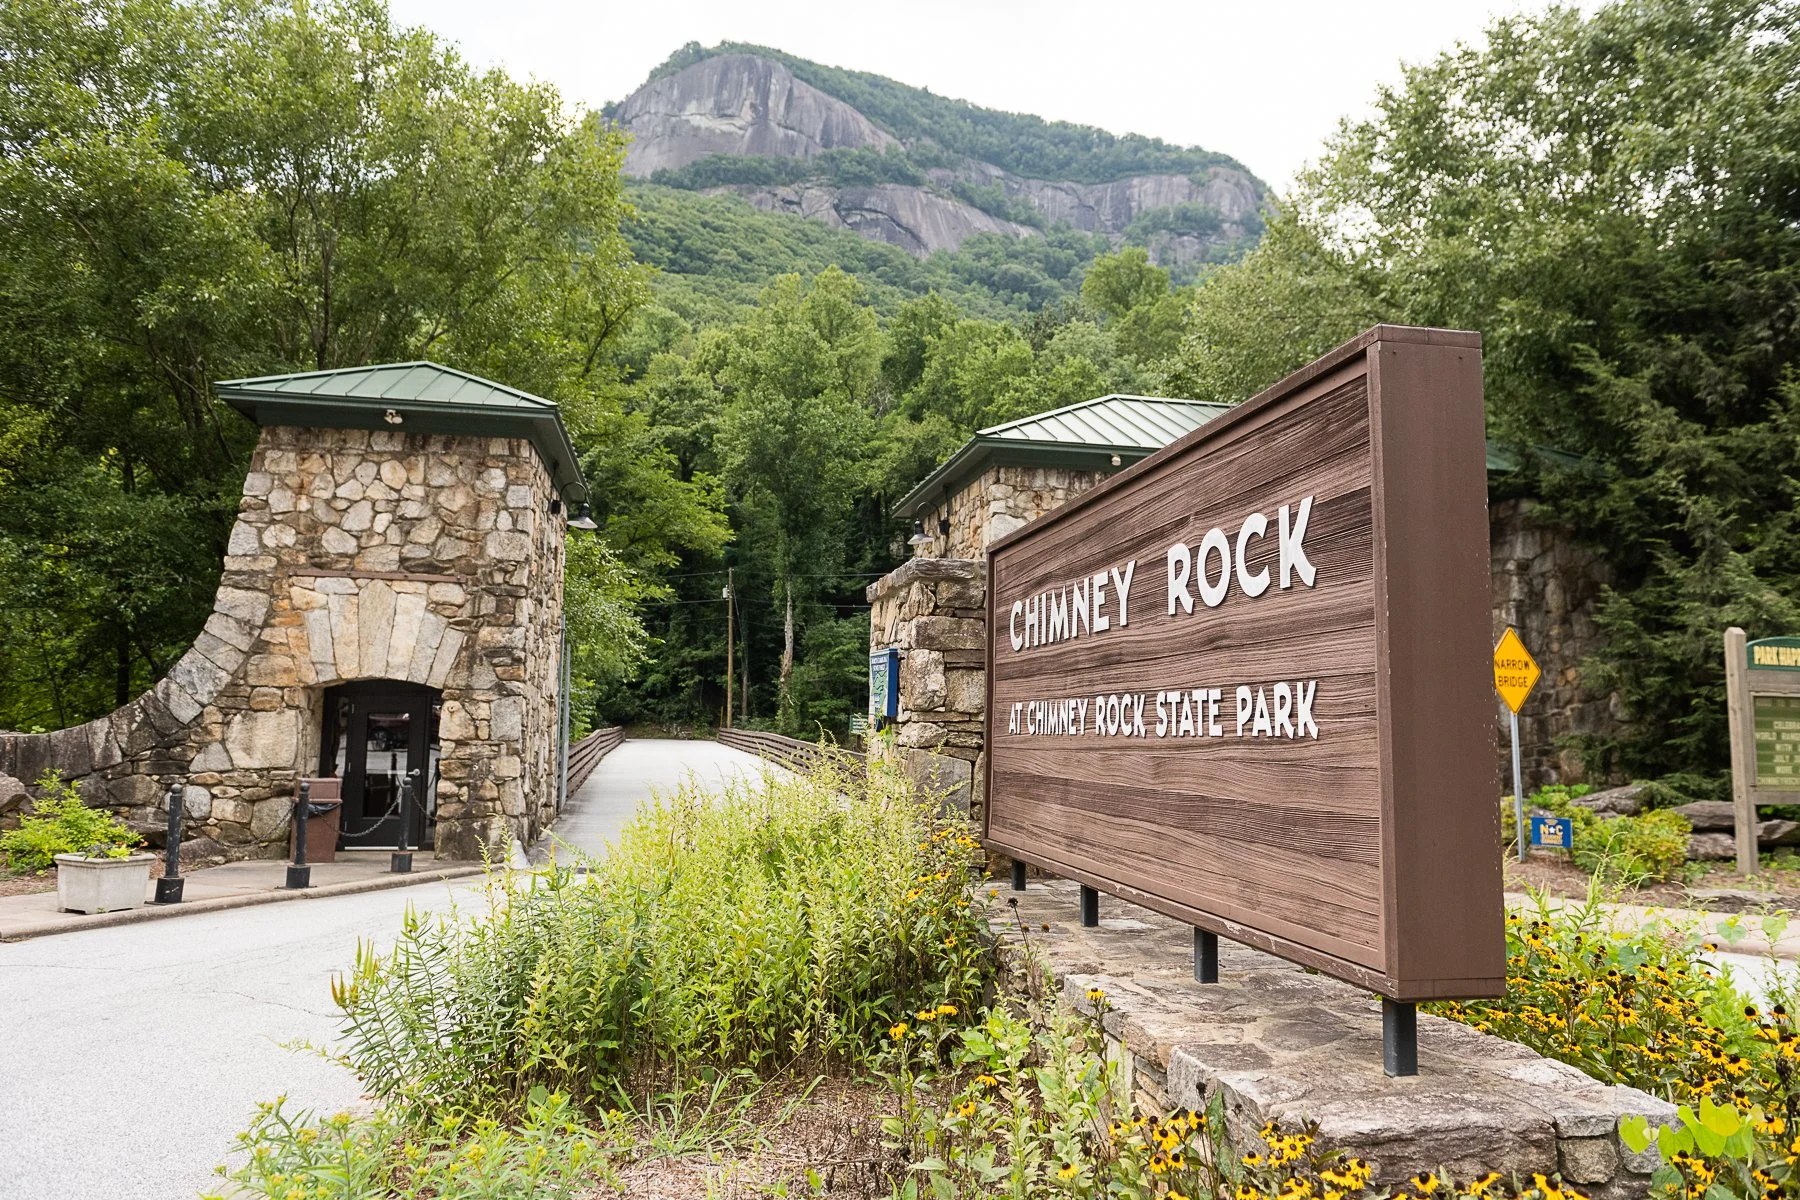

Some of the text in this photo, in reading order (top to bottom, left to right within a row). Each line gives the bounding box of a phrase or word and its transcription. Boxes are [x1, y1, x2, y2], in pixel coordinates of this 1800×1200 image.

[1009, 495, 1317, 651] CHIMNEY ROCK
[1494, 659, 1530, 670] NARROW
[1754, 645, 1778, 665] PARK
[1498, 675, 1528, 687] BRIDGE
[1008, 680, 1320, 740] AT CHIMNEY ROCK STATE PARK
